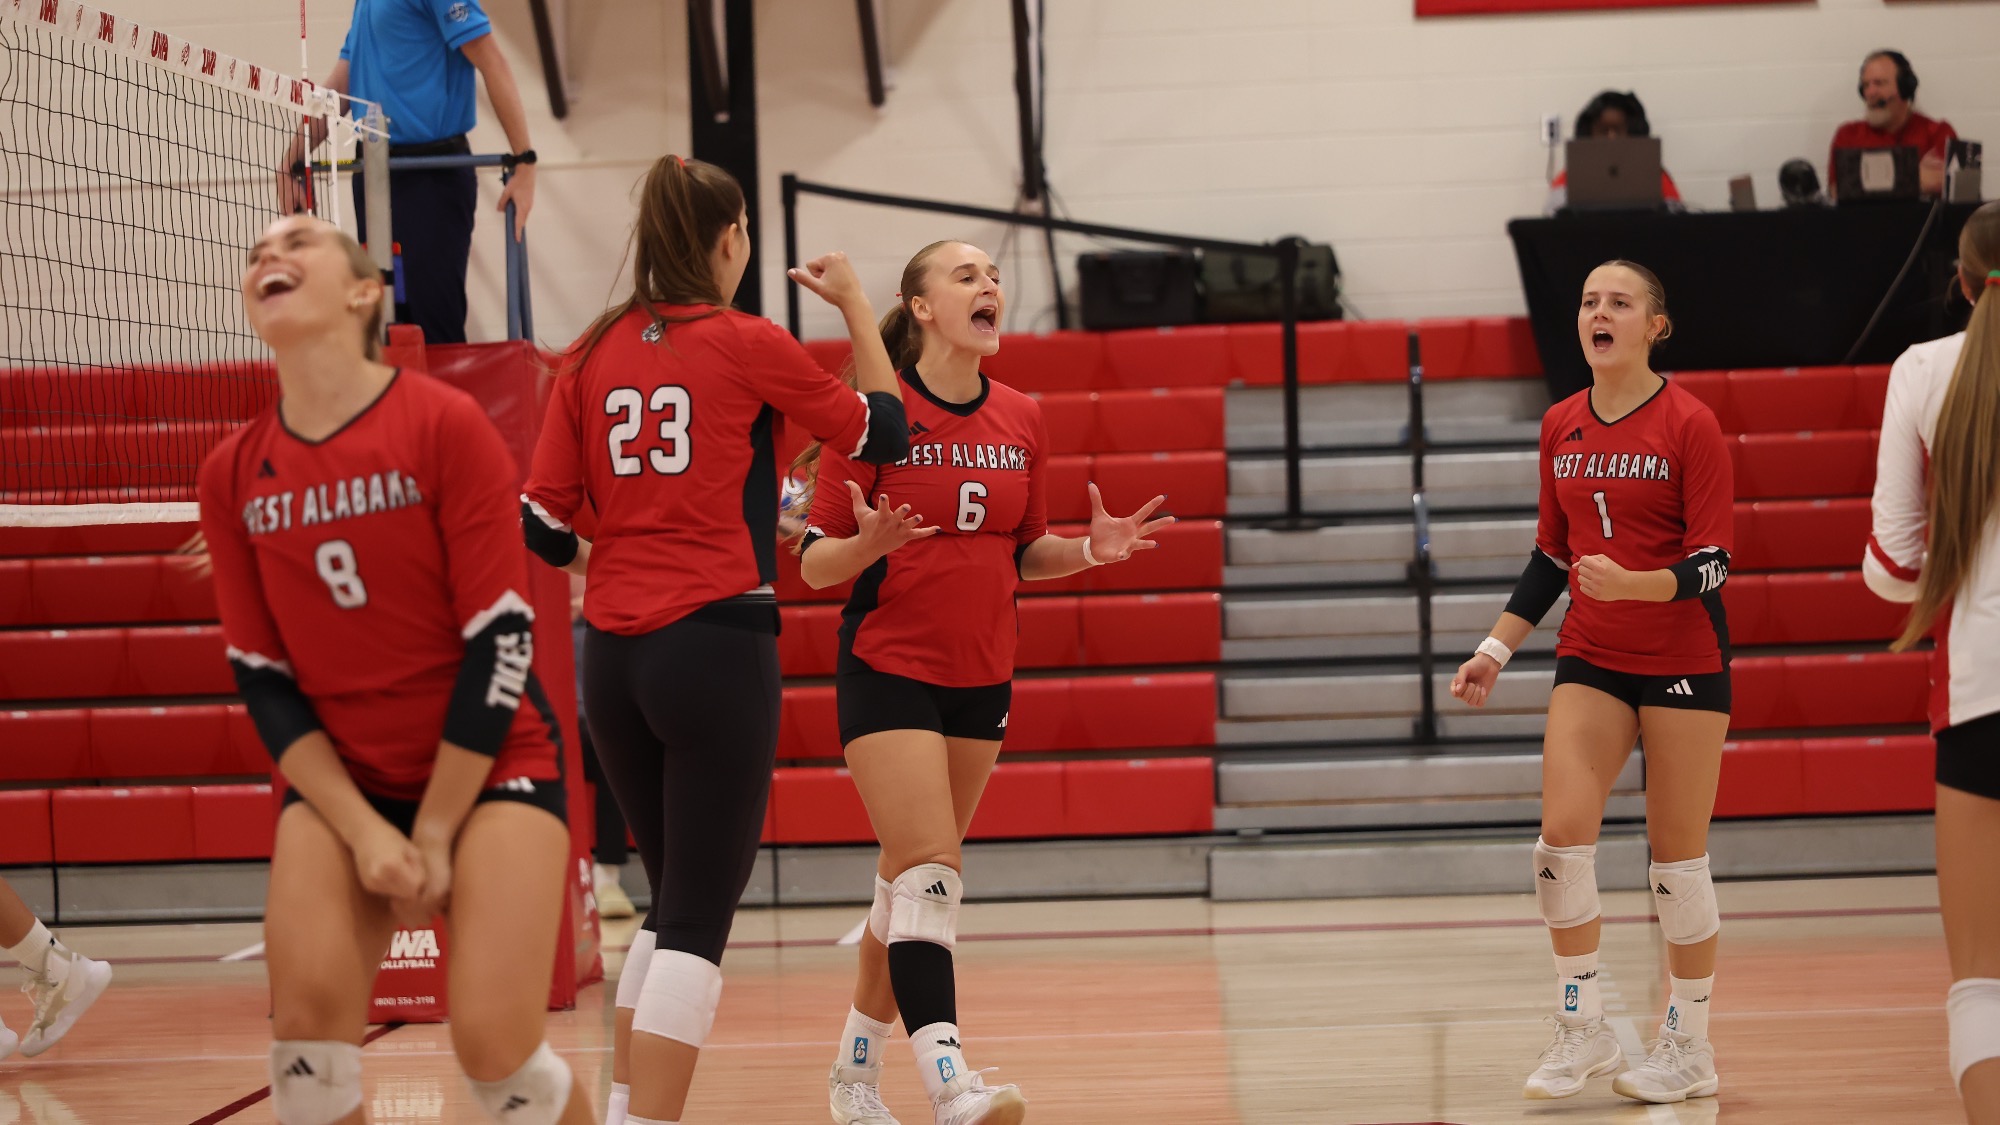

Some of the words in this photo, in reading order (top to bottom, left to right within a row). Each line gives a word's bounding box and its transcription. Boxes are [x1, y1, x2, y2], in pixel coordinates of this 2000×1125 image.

[604, 384, 692, 478] 23
[895, 443, 943, 467] EST
[951, 443, 1026, 470] ALABAMA
[1553, 453, 1584, 480] WEST
[1583, 453, 1670, 481] ALABAMA
[955, 481, 988, 532] 6
[1592, 490, 1613, 539] 1
[314, 539, 368, 610] 8
[383, 929, 441, 959] WA
